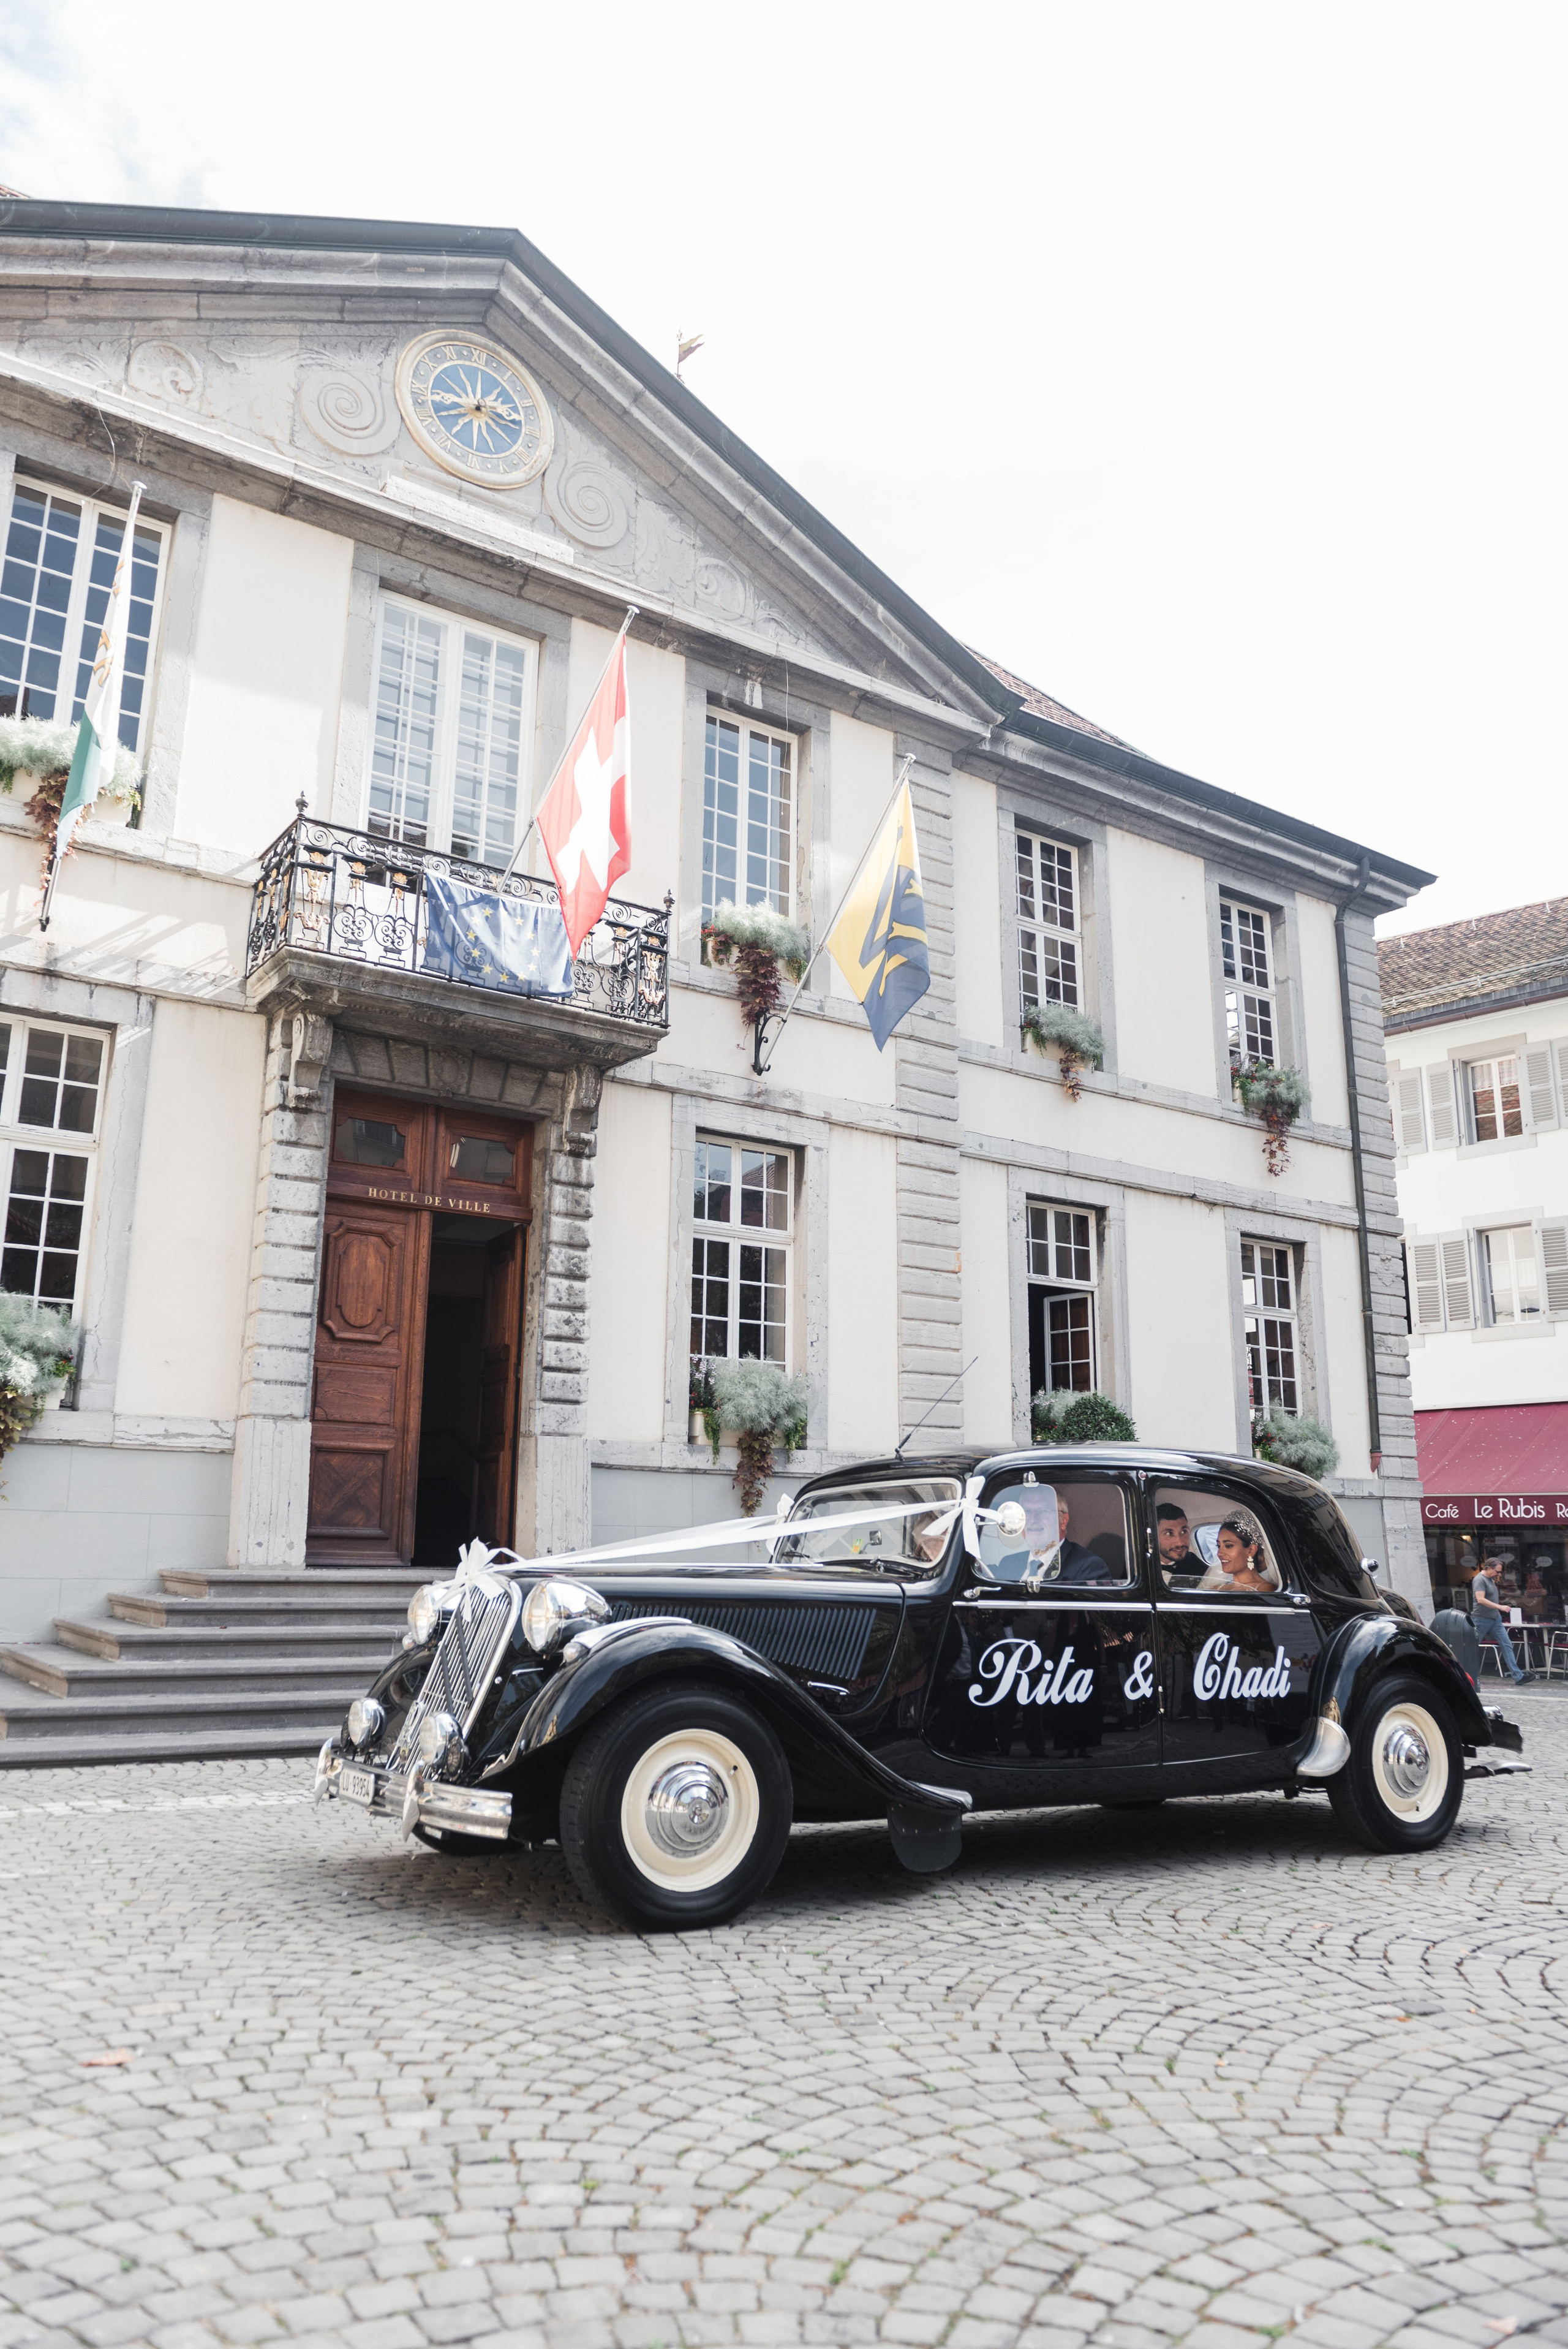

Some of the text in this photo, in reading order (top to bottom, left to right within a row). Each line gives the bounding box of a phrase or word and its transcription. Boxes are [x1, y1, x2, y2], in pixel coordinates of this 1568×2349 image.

[441, 345, 457, 361] XI
[470, 347, 486, 366] XII
[420, 355, 438, 372] X
[502, 371, 513, 381] I
[411, 379, 428, 396] IX
[521, 399, 534, 408] II
[525, 427, 541, 439] III
[434, 434, 452, 453] VII
[466, 453, 481, 471] VI
[499, 461, 510, 474] V
[368, 1187, 491, 1212] HOTEL DE VILLE
[1425, 1504, 1460, 1518] Café
[1474, 1498, 1493, 1518] Le
[1498, 1498, 1545, 1518] Rubis
[968, 1632, 1291, 1706] Rita & Chadi
